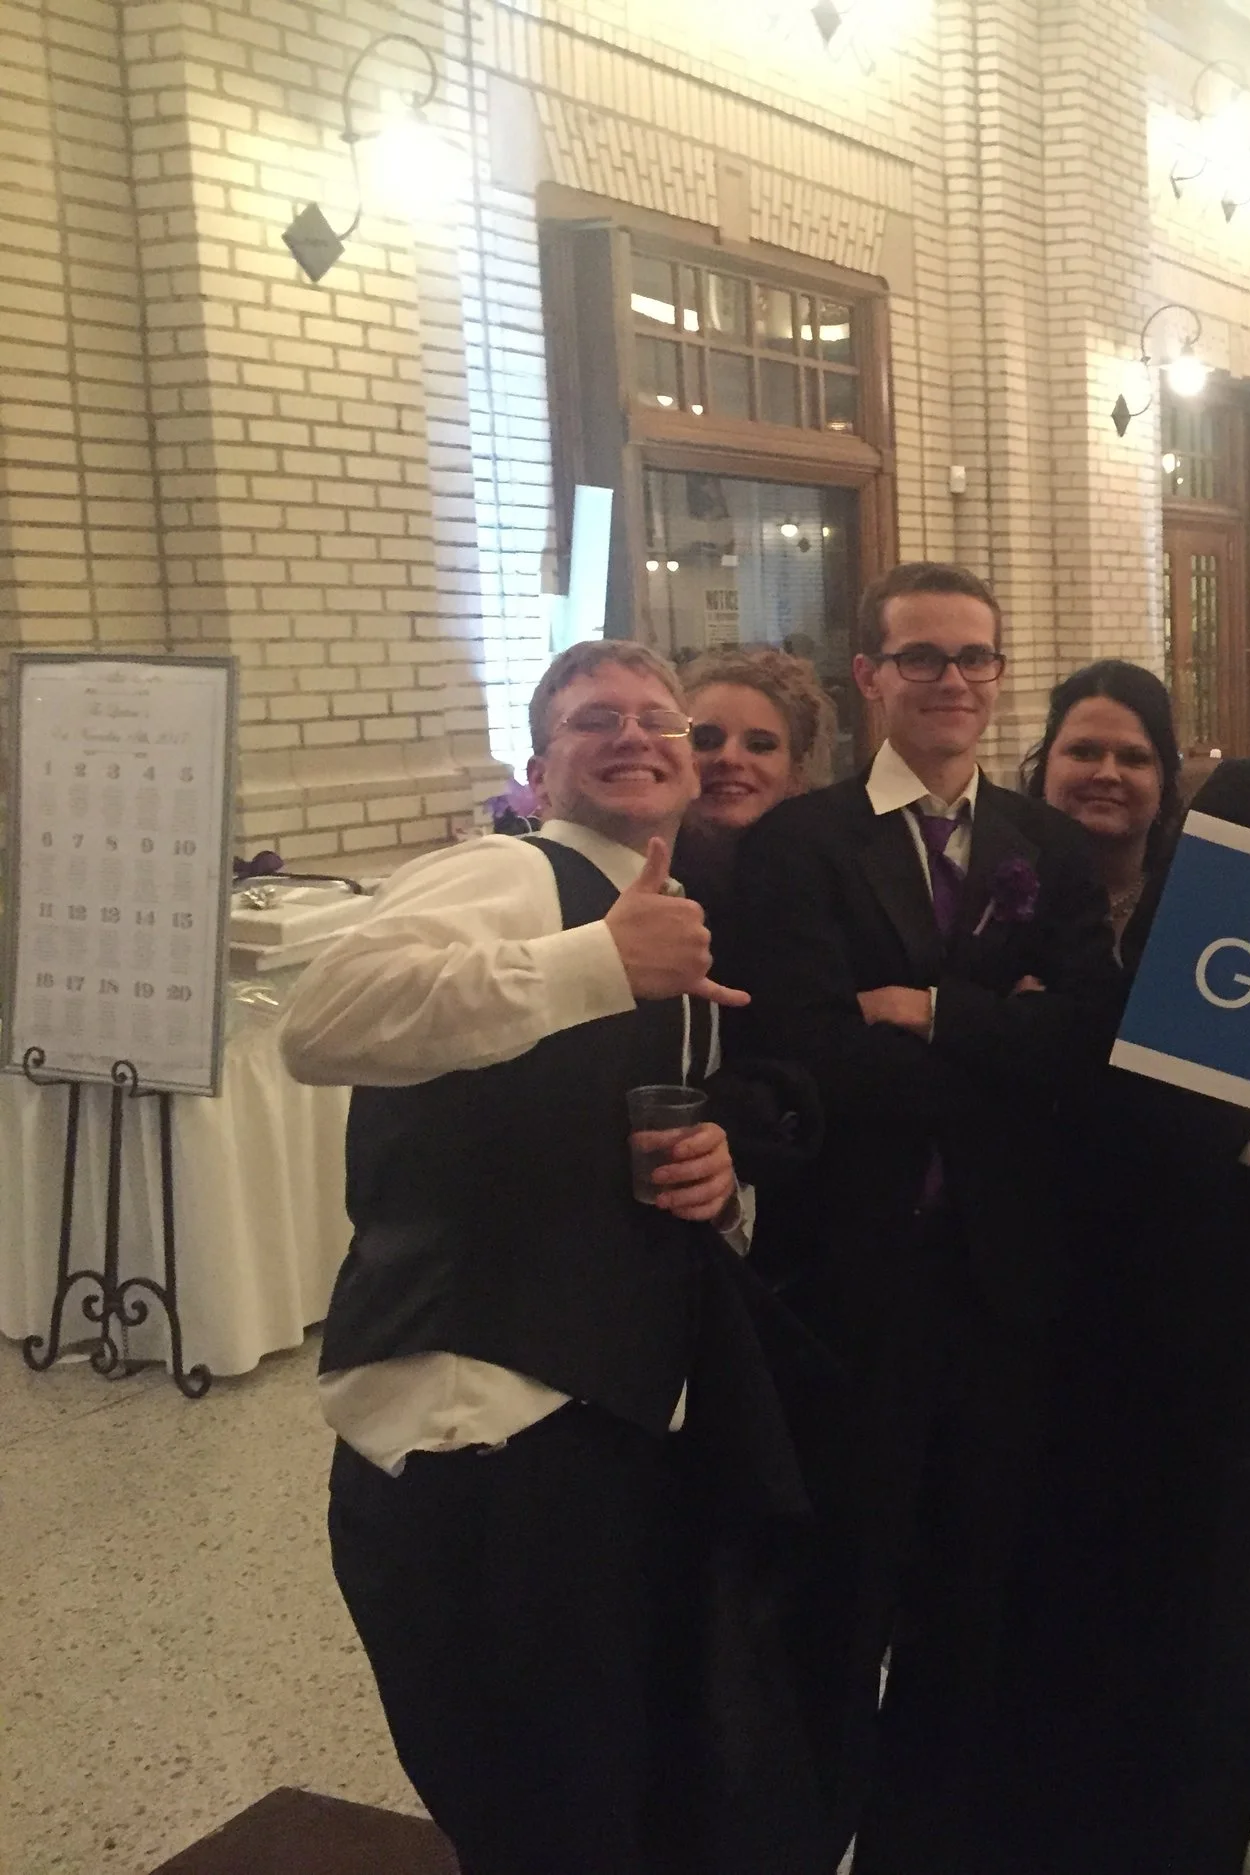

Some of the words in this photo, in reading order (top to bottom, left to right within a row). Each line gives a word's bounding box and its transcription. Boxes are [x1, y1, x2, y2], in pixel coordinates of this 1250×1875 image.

[44, 760, 52, 775] 1
[74, 762, 86, 777] 2
[107, 763, 120, 779] 3
[143, 766, 155, 781] 4
[42, 831, 53, 848] 6
[72, 833, 84, 848] 7
[141, 837, 154, 853] 9
[174, 839, 196, 856] 10
[39, 902, 53, 918] 11
[68, 904, 87, 921] 12
[101, 906, 120, 924] 13
[136, 910, 155, 926] 14
[172, 912, 193, 929] 15
[36, 972, 54, 988] 16
[66, 975, 85, 992] 17
[134, 981, 154, 998] 19
[167, 984, 192, 1001] 20
